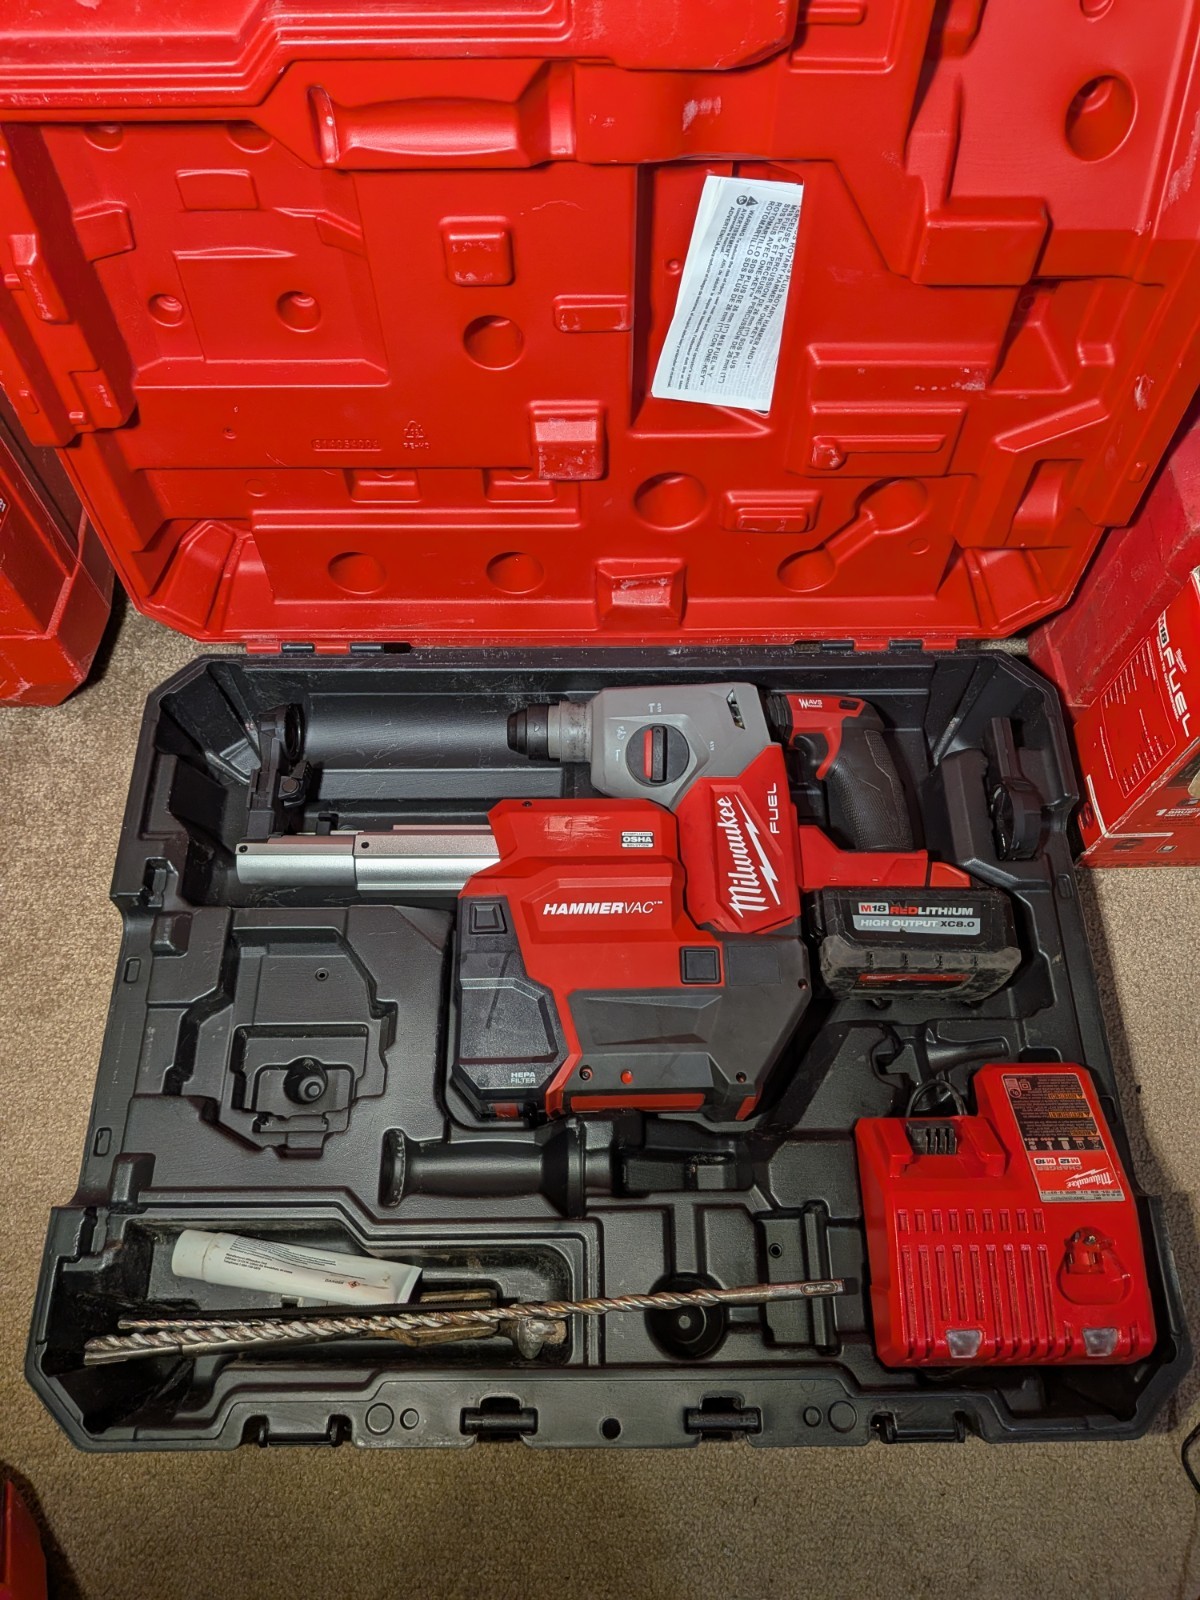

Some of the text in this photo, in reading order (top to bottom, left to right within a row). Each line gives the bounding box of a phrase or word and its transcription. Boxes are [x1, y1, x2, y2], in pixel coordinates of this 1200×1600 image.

[779, 204, 790, 217] SDS
[787, 205, 797, 216] M18
[739, 210, 754, 236] WARNING
[747, 201, 775, 255] ROTOMARTILLO
[754, 202, 782, 257] ROTOMARTILLO
[770, 218, 783, 235] PLUS
[783, 205, 802, 242] ERCEUSE
[724, 208, 747, 257] AVERTISSEMENT
[762, 236, 774, 258] AVEC
[771, 244, 779, 255] ET
[741, 257, 751, 272] SDS
[781, 242, 795, 273] ROTARY
[748, 259, 757, 274] SDS
[755, 256, 774, 294] PERCEUSE
[761, 252, 783, 298] PERCUSSION
[733, 274, 744, 292] PLUS
[740, 275, 751, 294] PLUS
[767, 274, 783, 303] HAMMER
[778, 275, 790, 293] PLUS
[729, 293, 737, 302] DE
[736, 295, 744, 303] DE
[757, 298, 764, 307] DE
[766, 294, 782, 319] ROTARY
[720, 312, 728, 322] mm
[727, 312, 735, 323] mm
[734, 301, 755, 340] PERCUSSION
[747, 316, 755, 326] mm
[710, 333, 719, 347] CON
[717, 334, 726, 346] M18
[753, 320, 769, 345] HAMMER
[729, 341, 738, 350] DE
[747, 346, 756, 360] AND
[722, 359, 729, 371] mm
[730, 351, 740, 369] PLUS
[1163, 646, 1191, 738] FUEL
[767, 783, 780, 834] FUEL
[717, 795, 769, 918] Milwaukee
[860, 904, 974, 916] M18 REDLITHIUM
[860, 919, 976, 928] HIGH OUTPUT XC8.0
[1066, 1172, 1114, 1189] Milwaukee
